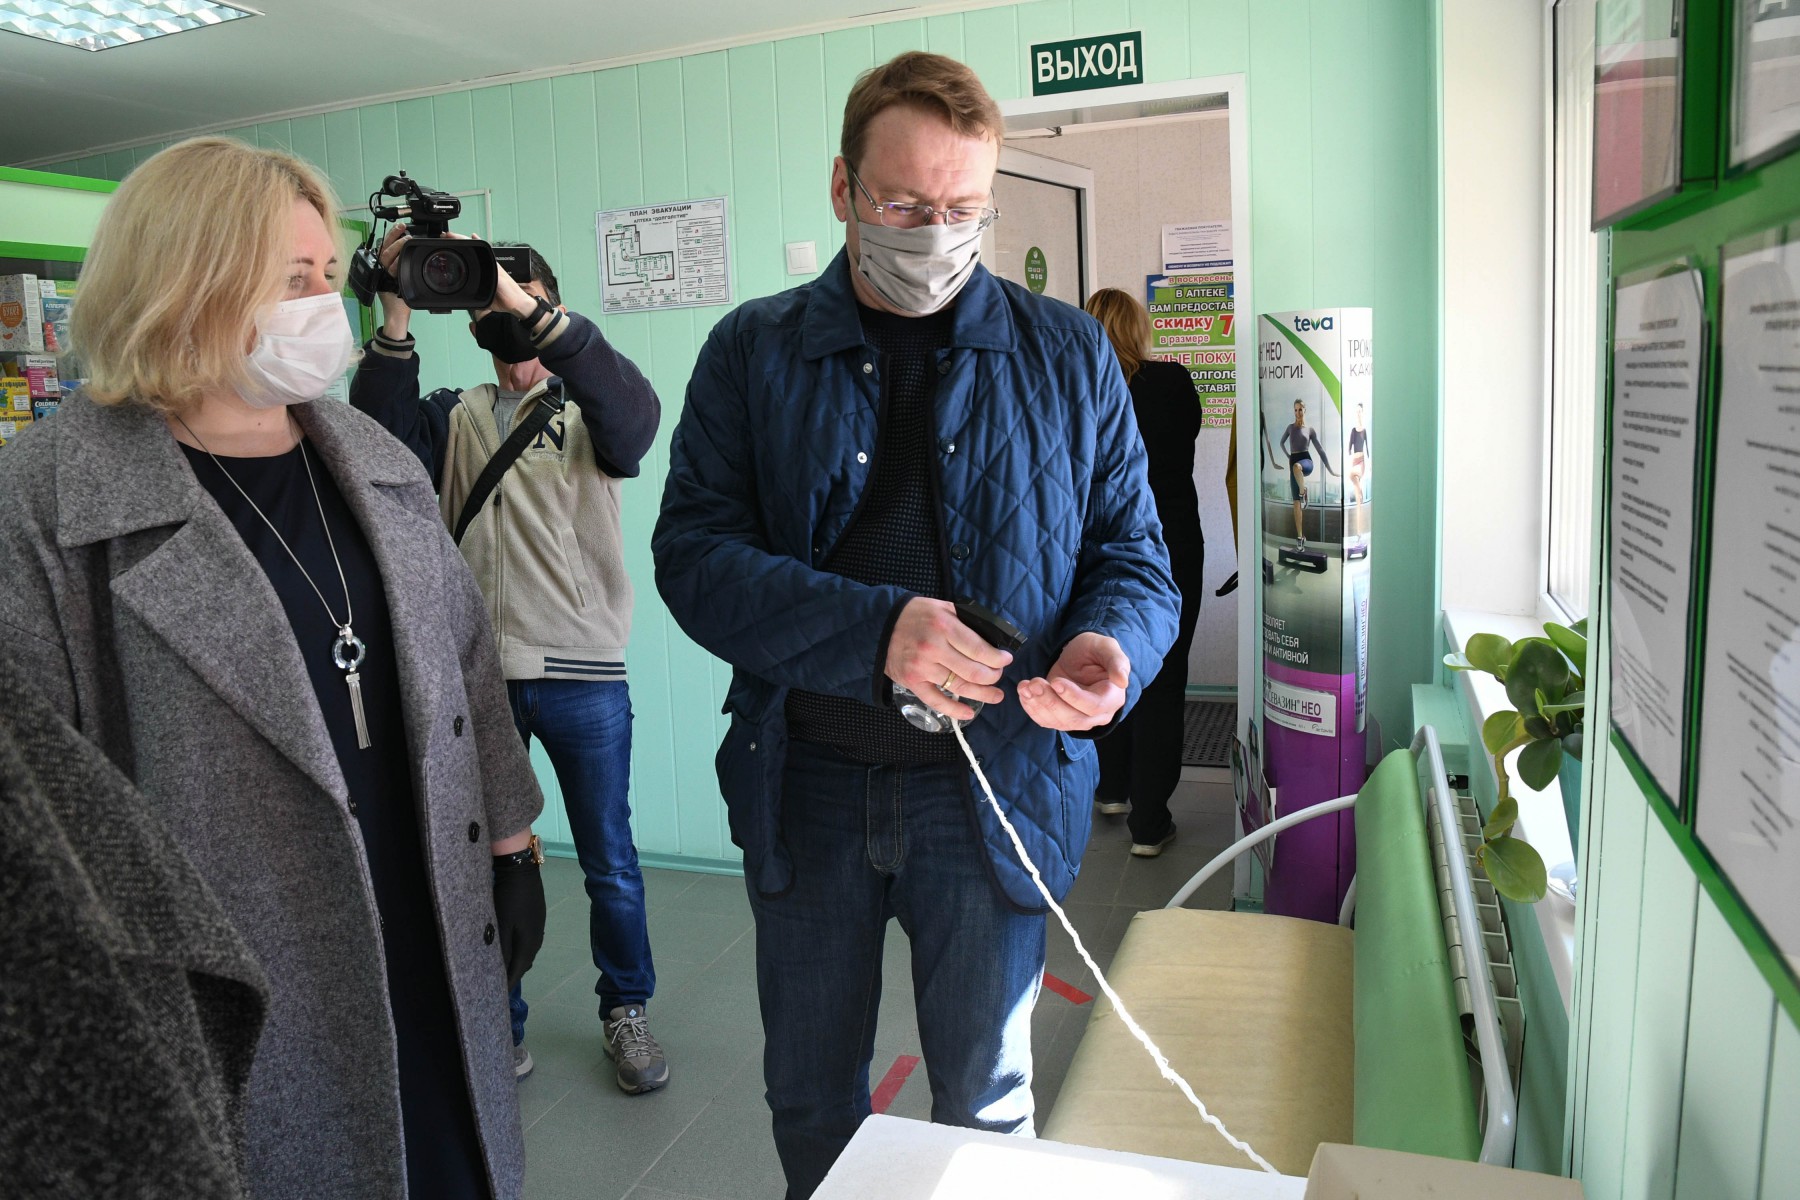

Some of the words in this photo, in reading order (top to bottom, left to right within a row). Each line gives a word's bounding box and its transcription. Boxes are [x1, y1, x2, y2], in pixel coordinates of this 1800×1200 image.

[1037, 40, 1138, 83] ВЫХОД
[651, 205, 692, 214] ЭВАКУАЦИИ
[1176, 289, 1183, 298] В
[1186, 288, 1225, 298] АПТЕКЕ
[1149, 303, 1171, 313] ВАМ
[1174, 301, 1233, 312] ПРЕДОСТАВ
[1219, 314, 1234, 335] 7
[1294, 315, 1334, 332] teva
[1169, 334, 1209, 346] размере
[1188, 369, 1236, 380] олголе
[1268, 363, 1304, 379] НОГИ!
[1194, 383, 1236, 393] СТАВЯТ
[1208, 416, 1232, 427] будн
[532, 421, 565, 451] N
[1281, 634, 1300, 649] СЕБЯ
[1272, 646, 1309, 665] АКТИВНОЙ
[1301, 700, 1321, 717] НЕО
